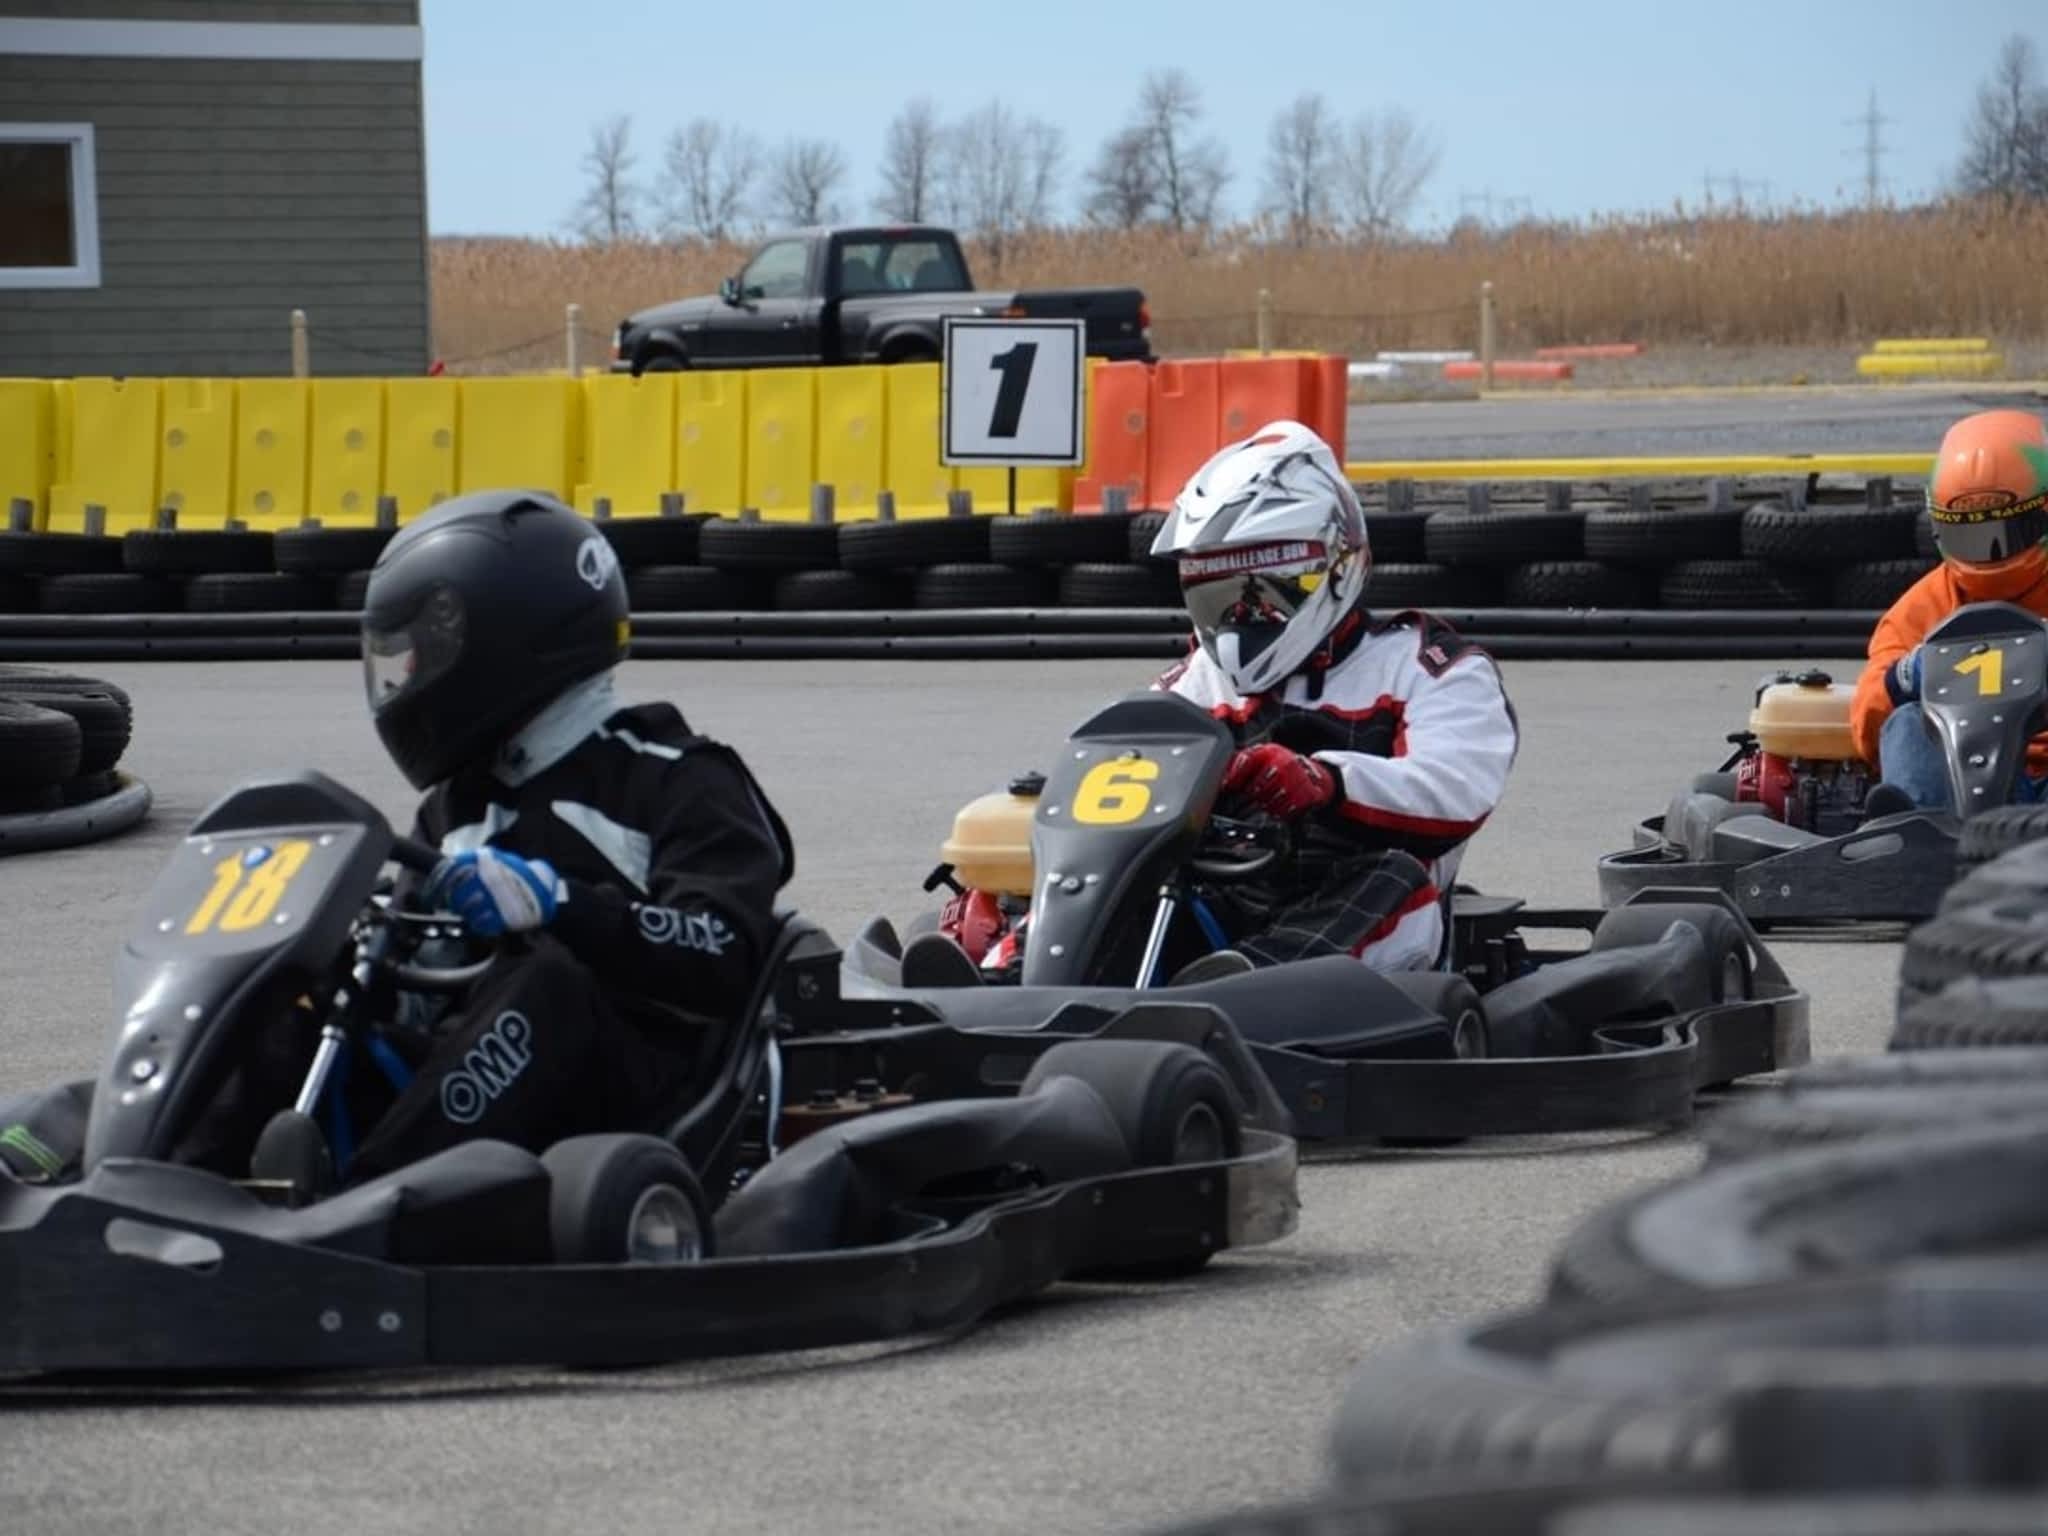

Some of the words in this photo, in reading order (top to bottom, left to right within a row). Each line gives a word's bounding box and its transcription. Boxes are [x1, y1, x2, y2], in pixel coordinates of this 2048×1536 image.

[987, 341, 1038, 438] 1
[1953, 648, 2003, 695] 1
[1072, 757, 1160, 824] 6
[184, 838, 312, 936] 18
[441, 1010, 531, 1123] OMP
